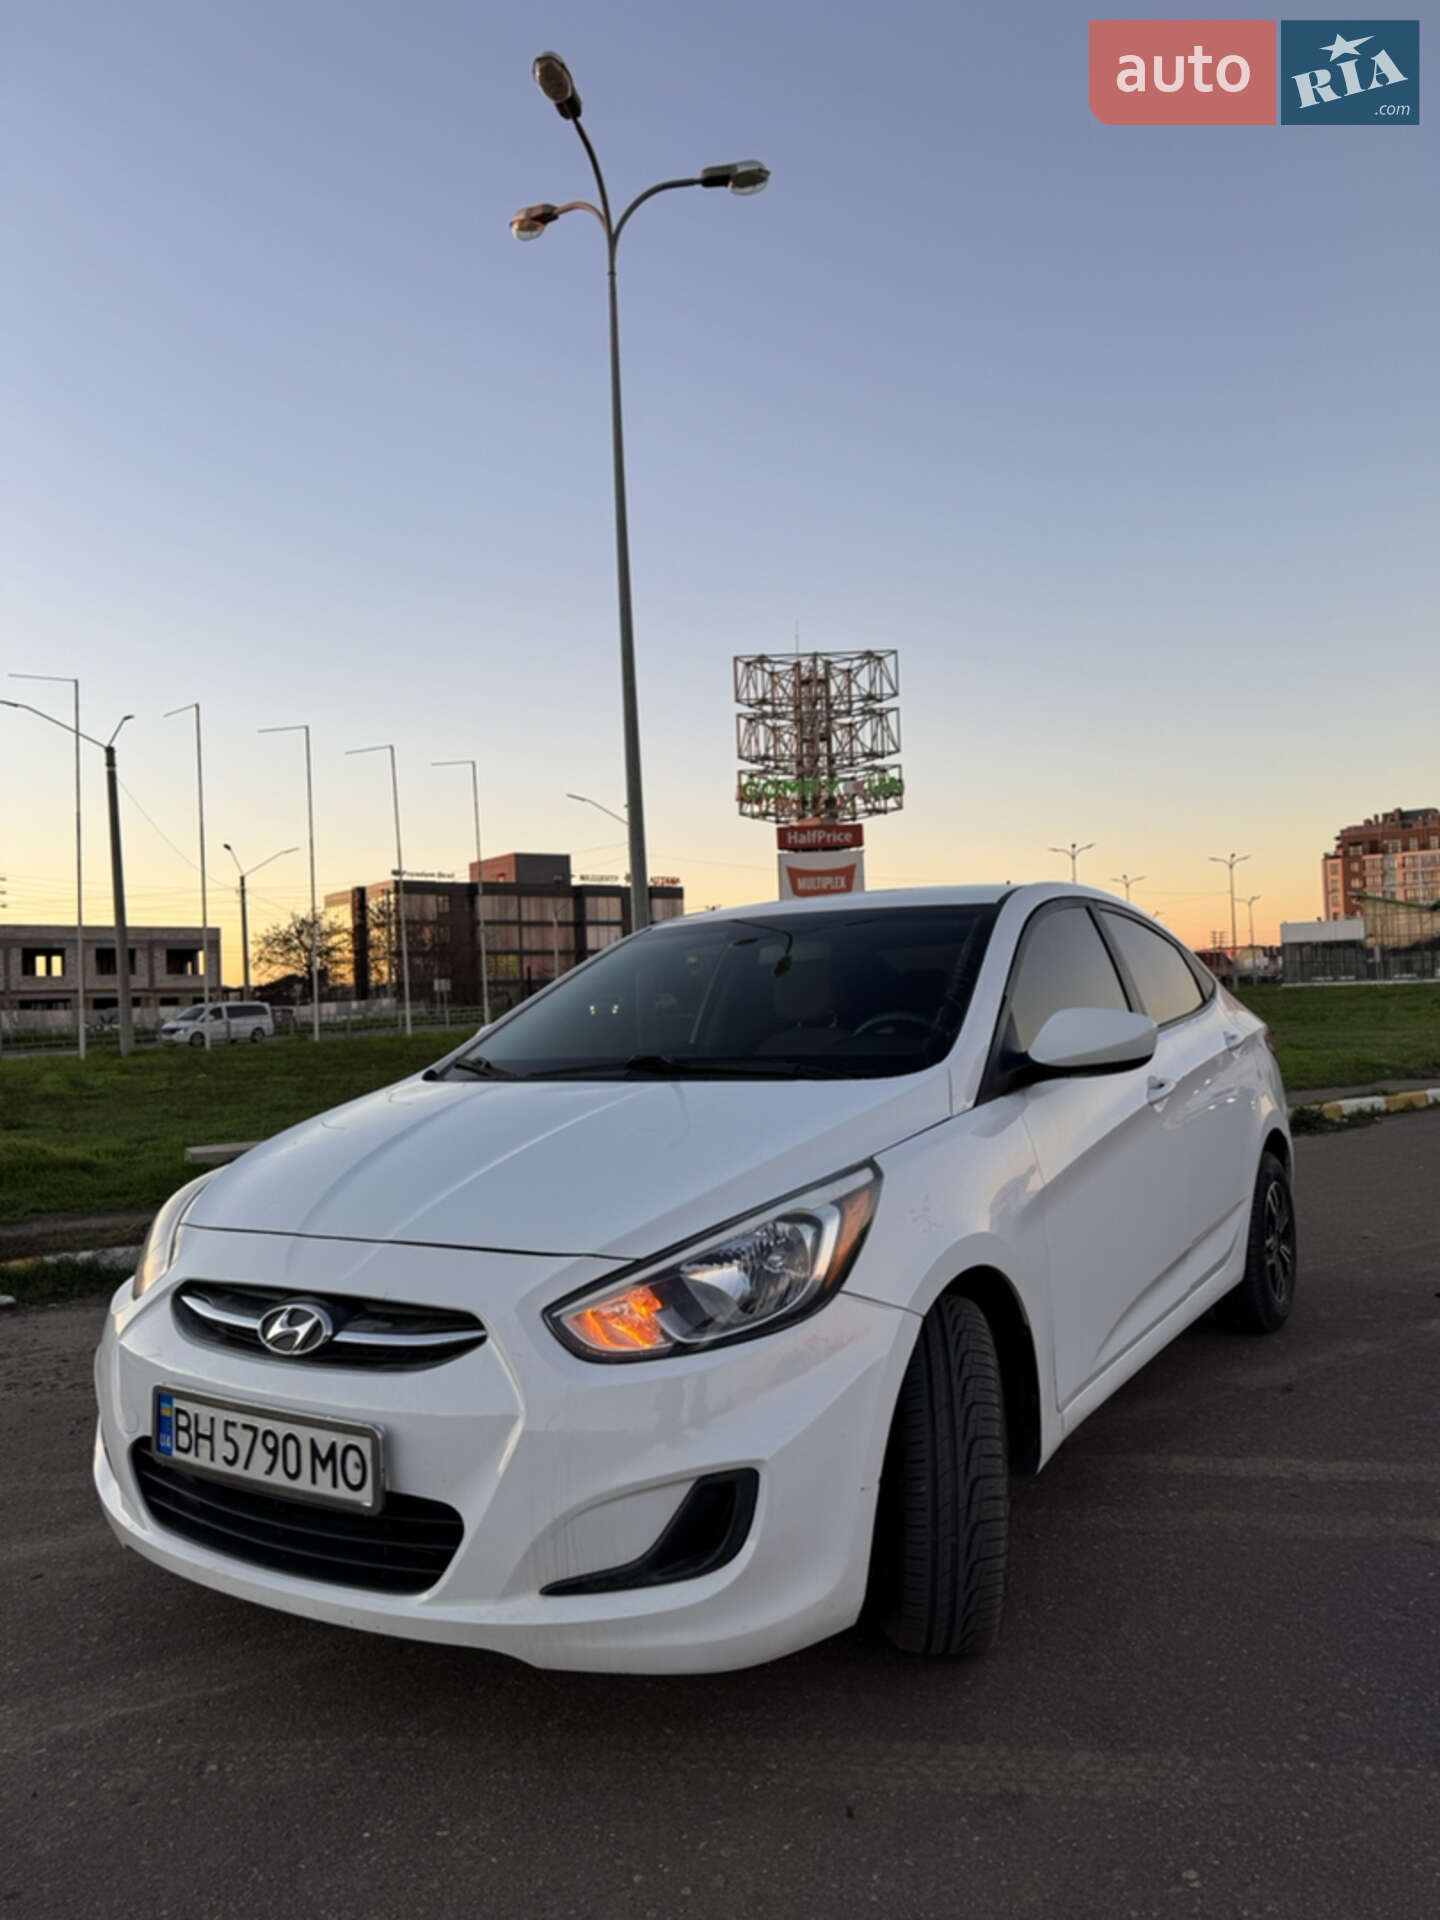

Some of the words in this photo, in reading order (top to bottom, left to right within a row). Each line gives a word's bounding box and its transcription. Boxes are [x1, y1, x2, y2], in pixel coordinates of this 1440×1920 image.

[786, 829, 853, 844] HalfPrice
[796, 876, 848, 890] MULTIPLEX
[174, 1406, 216, 1463] BH
[221, 1419, 302, 1481] 5790
[309, 1436, 368, 1492] MO
